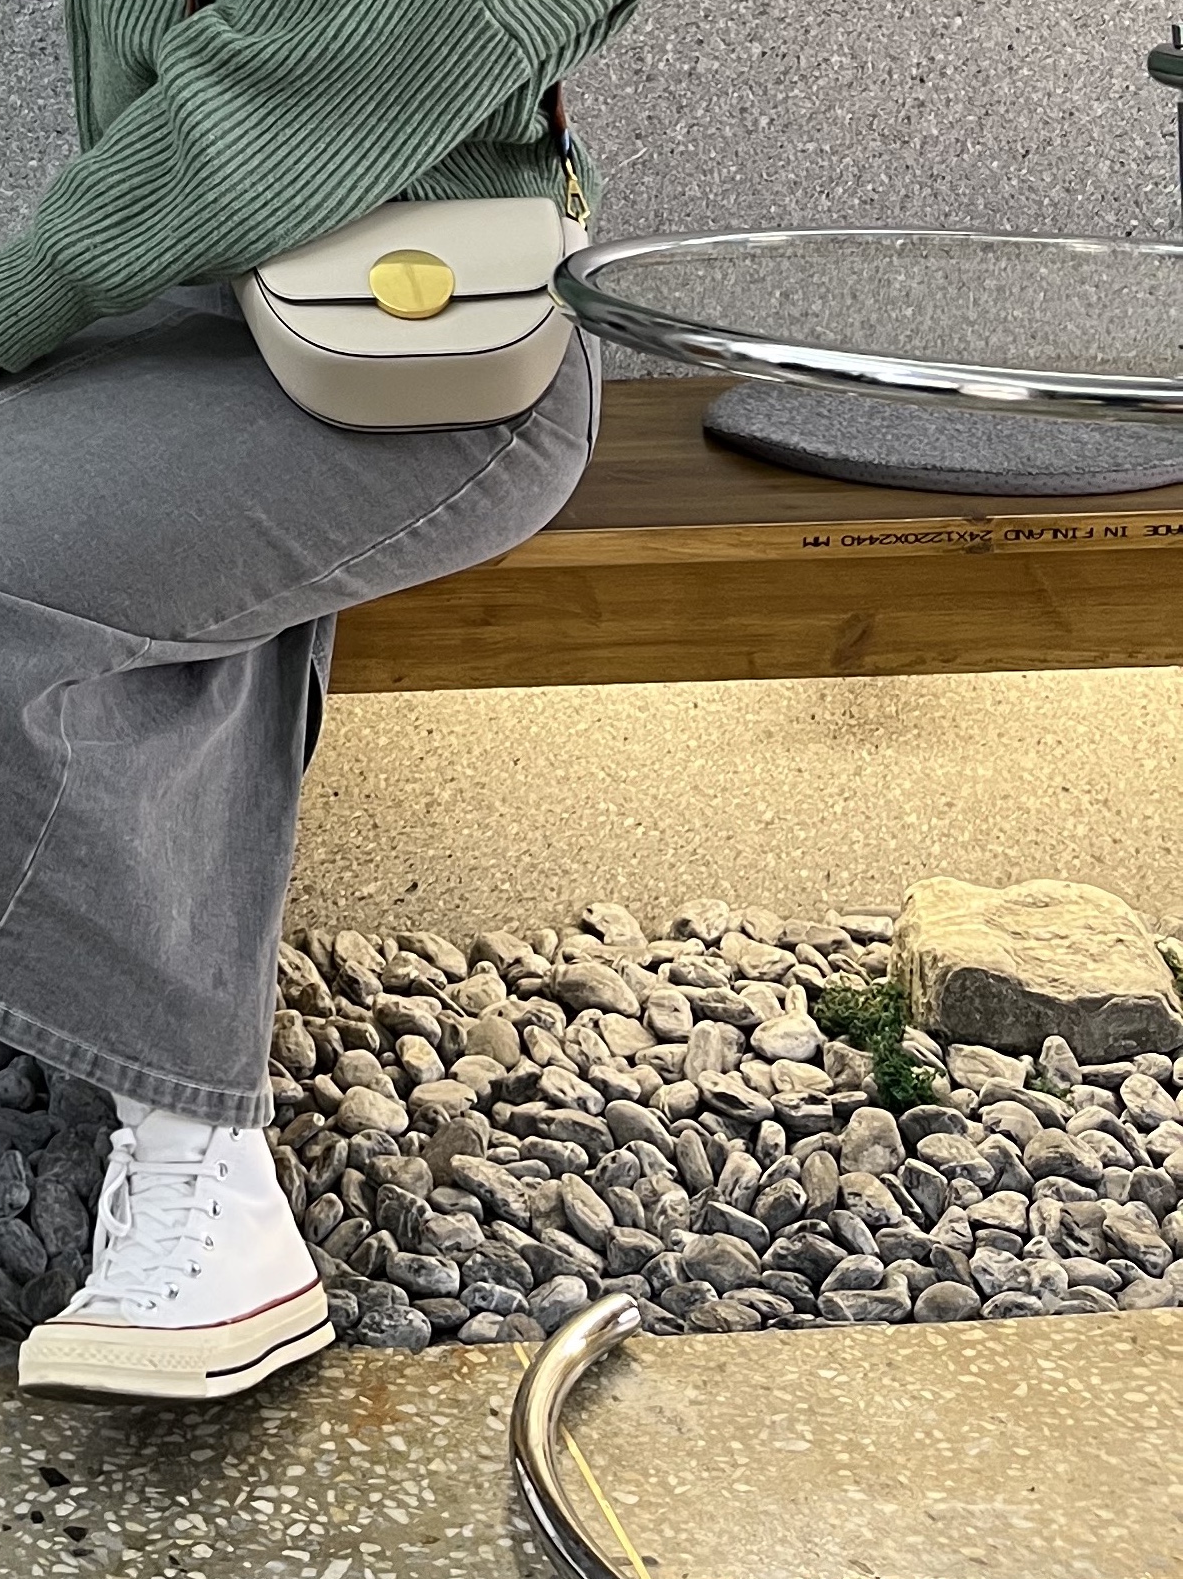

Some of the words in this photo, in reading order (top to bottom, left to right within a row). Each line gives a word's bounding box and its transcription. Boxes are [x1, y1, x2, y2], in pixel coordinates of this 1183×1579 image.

[841, 529, 993, 547] 24X1220X2440
[1003, 526, 1094, 541] FINLAND
[1104, 525, 1128, 538] IN
[802, 535, 831, 548] MM
